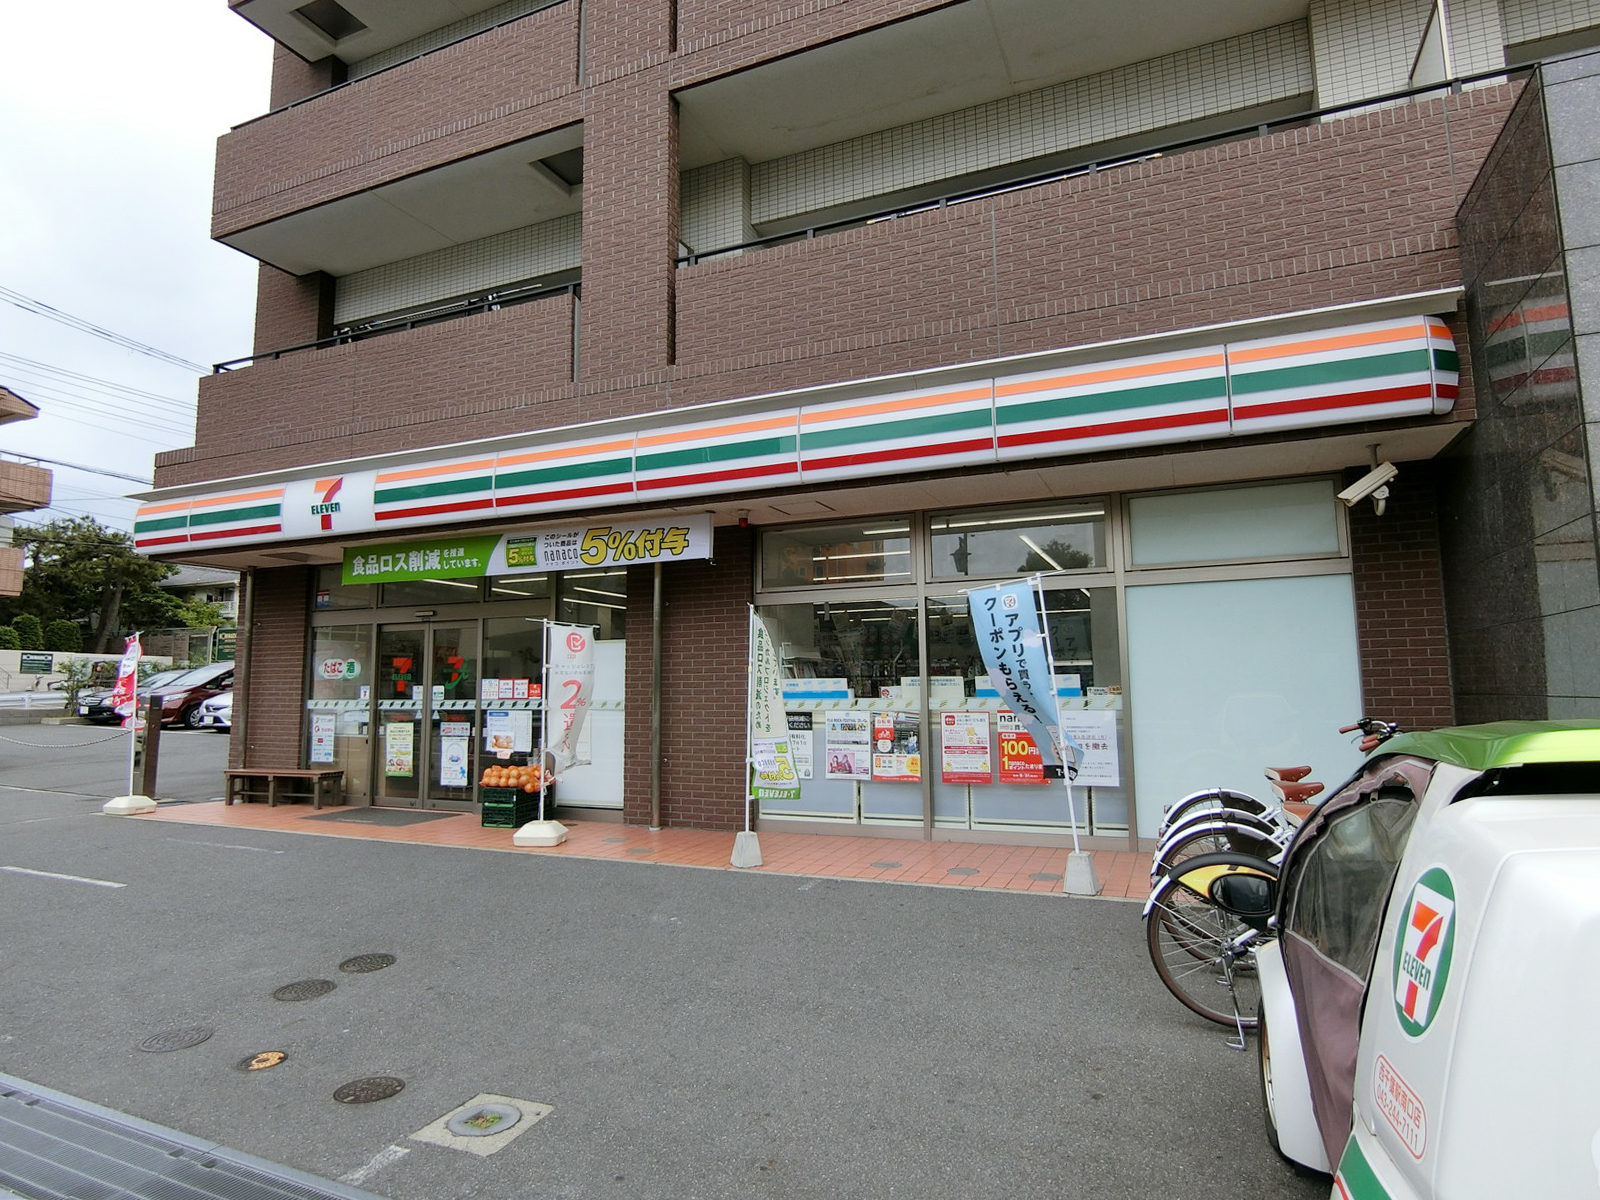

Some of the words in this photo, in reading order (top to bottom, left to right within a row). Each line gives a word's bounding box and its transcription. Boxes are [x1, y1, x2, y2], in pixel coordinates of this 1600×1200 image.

[314, 476, 343, 531] 7
[544, 548, 579, 562] nanaco
[580, 526, 690, 565] 5%付与
[352, 551, 441, 576] 食品ロス削減
[443, 558, 481, 570] しています。
[323, 661, 343, 674] たばこ
[346, 661, 356, 674] 酒
[1401, 900, 1444, 1020] 7
[1378, 1061, 1422, 1130] 西千葉駅南口店
[1377, 1083, 1418, 1151] 043-244-7111
